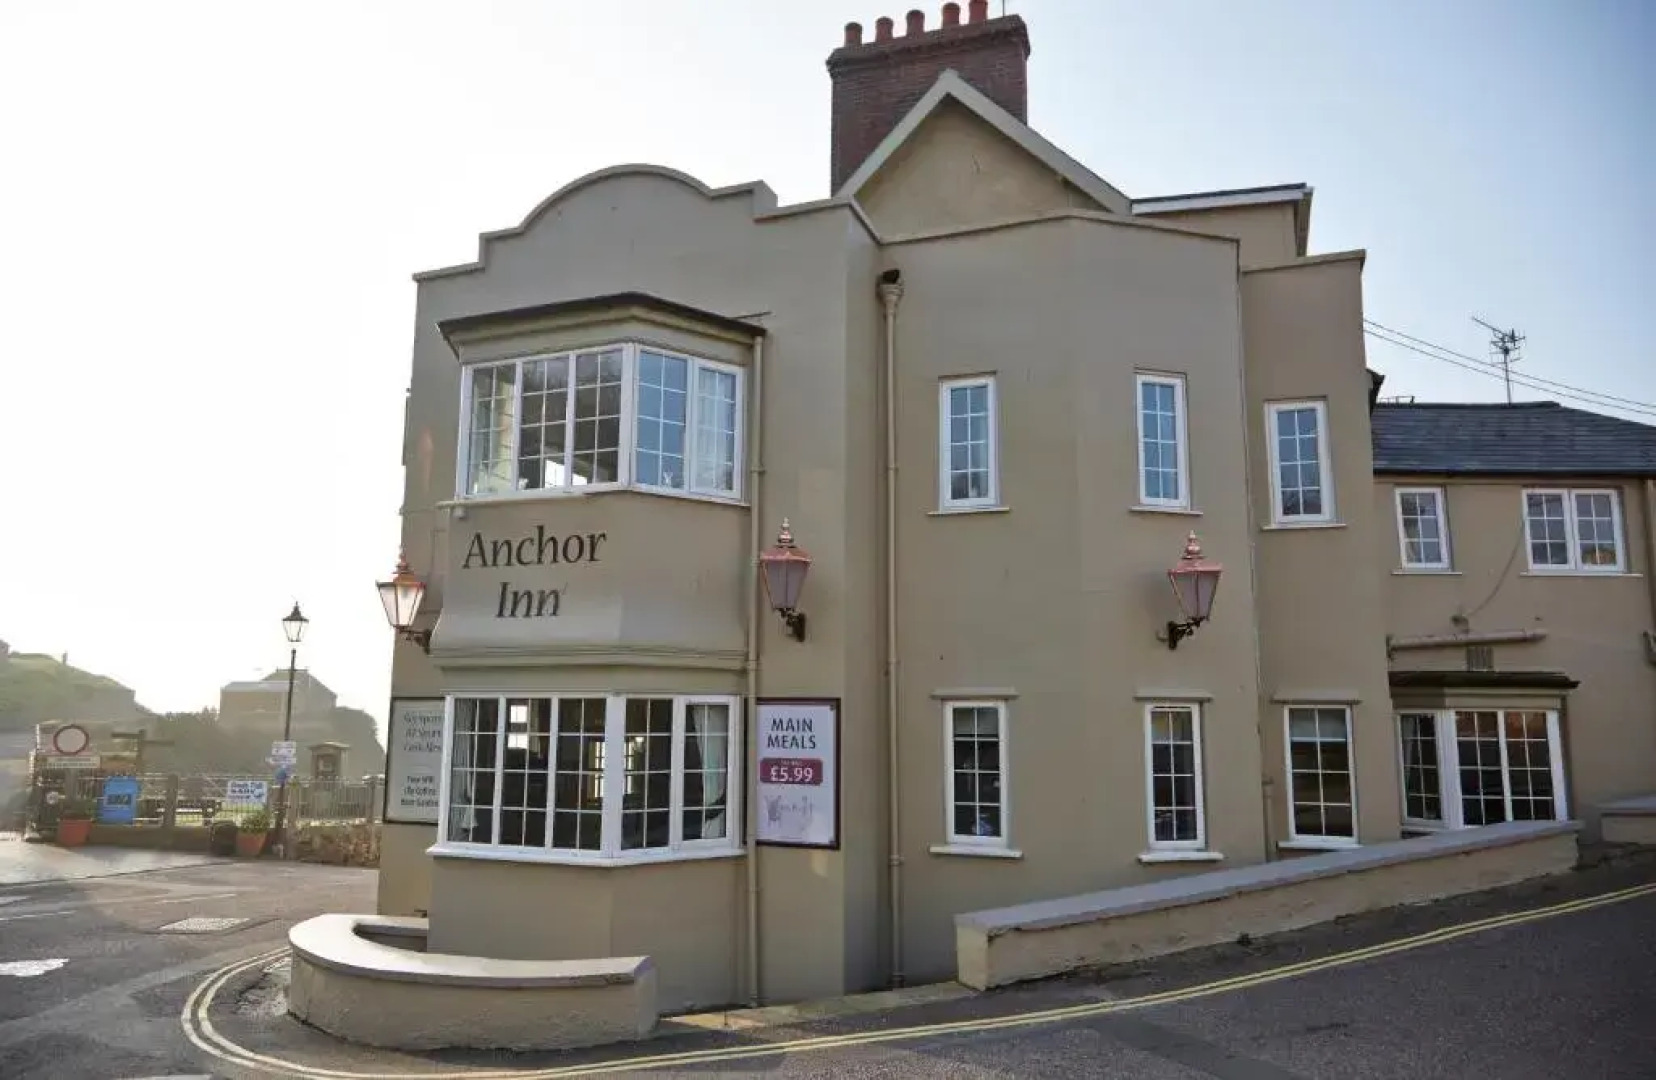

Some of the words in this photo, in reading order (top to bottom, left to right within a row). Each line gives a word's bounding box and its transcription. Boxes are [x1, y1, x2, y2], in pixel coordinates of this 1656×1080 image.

[462, 525, 607, 569] Anchor
[496, 581, 561, 618] Inn
[770, 717, 813, 732] MAIN
[767, 735, 817, 750] MEALS
[770, 767, 813, 783] £5.99
